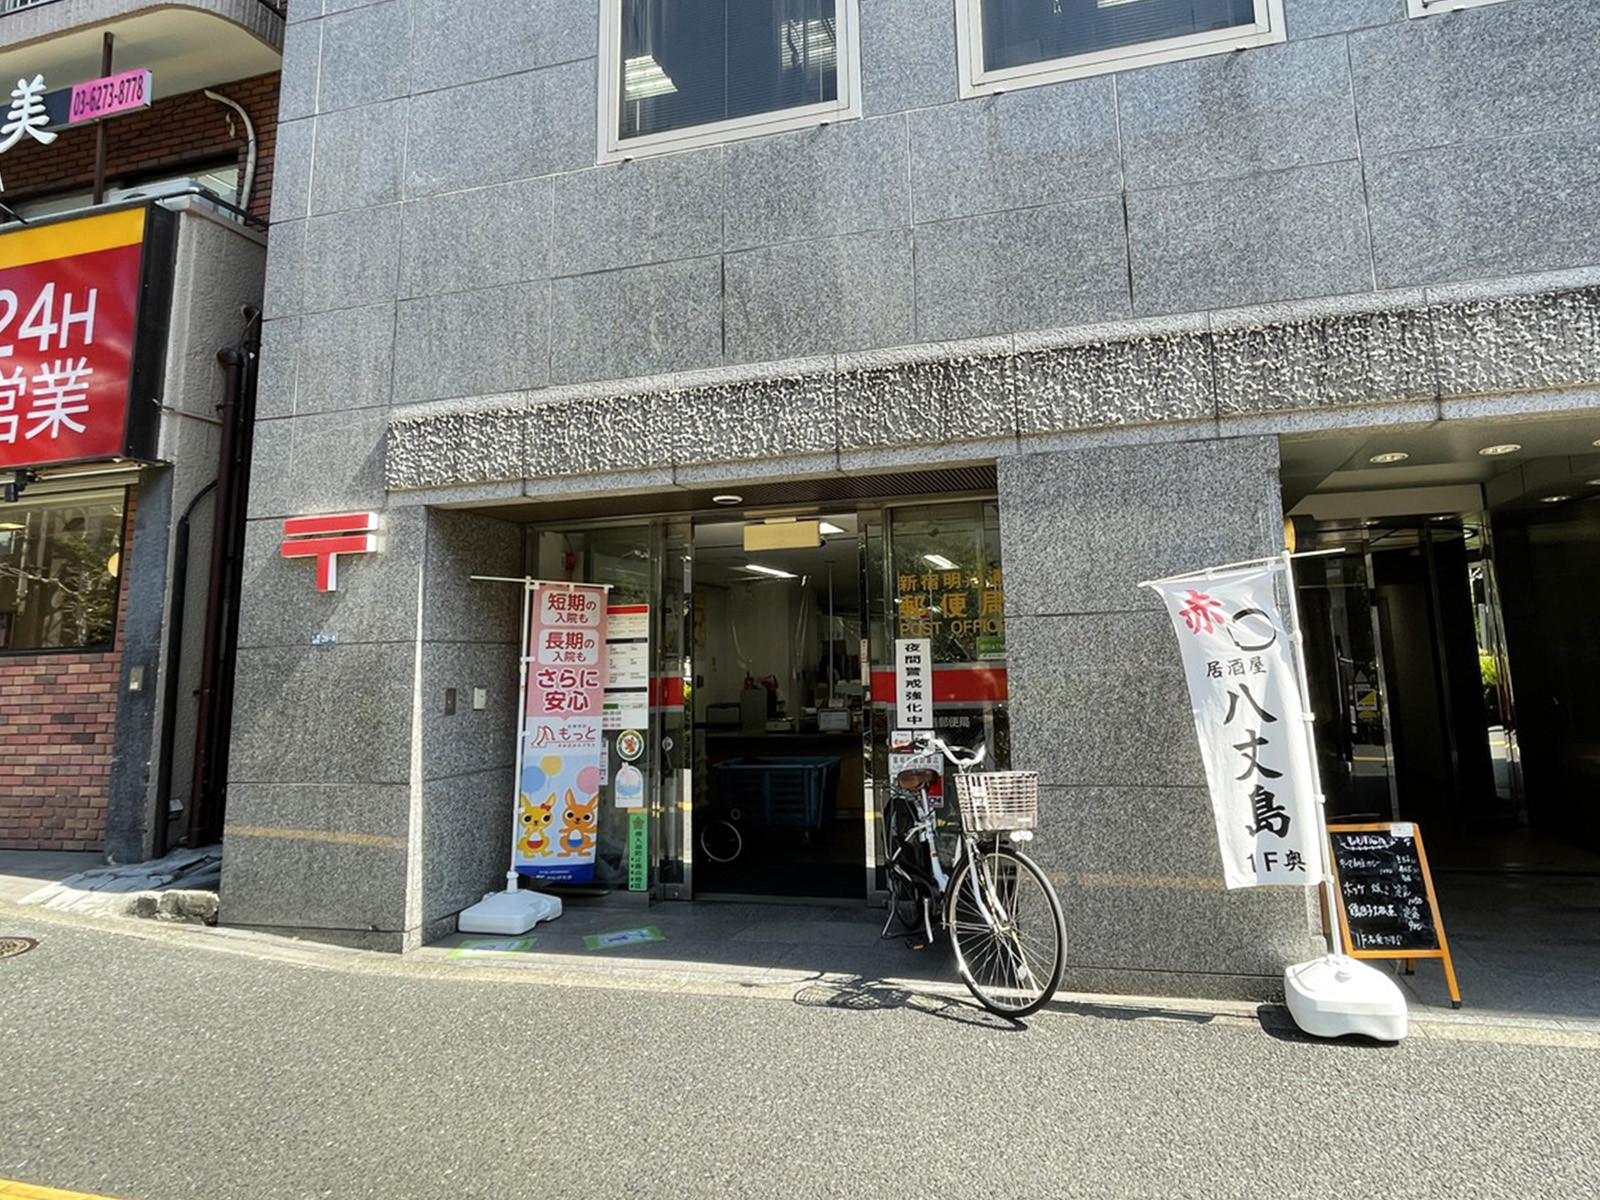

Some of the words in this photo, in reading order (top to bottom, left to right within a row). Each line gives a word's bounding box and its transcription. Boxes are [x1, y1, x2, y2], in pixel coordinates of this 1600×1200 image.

[73, 75, 144, 116] 03-6273-8778
[0, 73, 58, 154] 美
[0, 282, 98, 357] 24H
[547, 593, 597, 611] 短期の
[900, 590, 1003, 618] 郵便局
[555, 612, 589, 624] 入院も
[901, 621, 941, 637] POST
[545, 631, 595, 650] 長期の
[552, 651, 587, 662] 入院も
[1206, 656, 1268, 679] 居酒屋
[538, 668, 598, 688] さらに
[905, 643, 922, 725] 夜間警戒強化中
[545, 690, 588, 711] 安心
[559, 726, 596, 741] もっと
[1224, 683, 1291, 838] 八丈島
[1247, 850, 1307, 873] 1F奥
